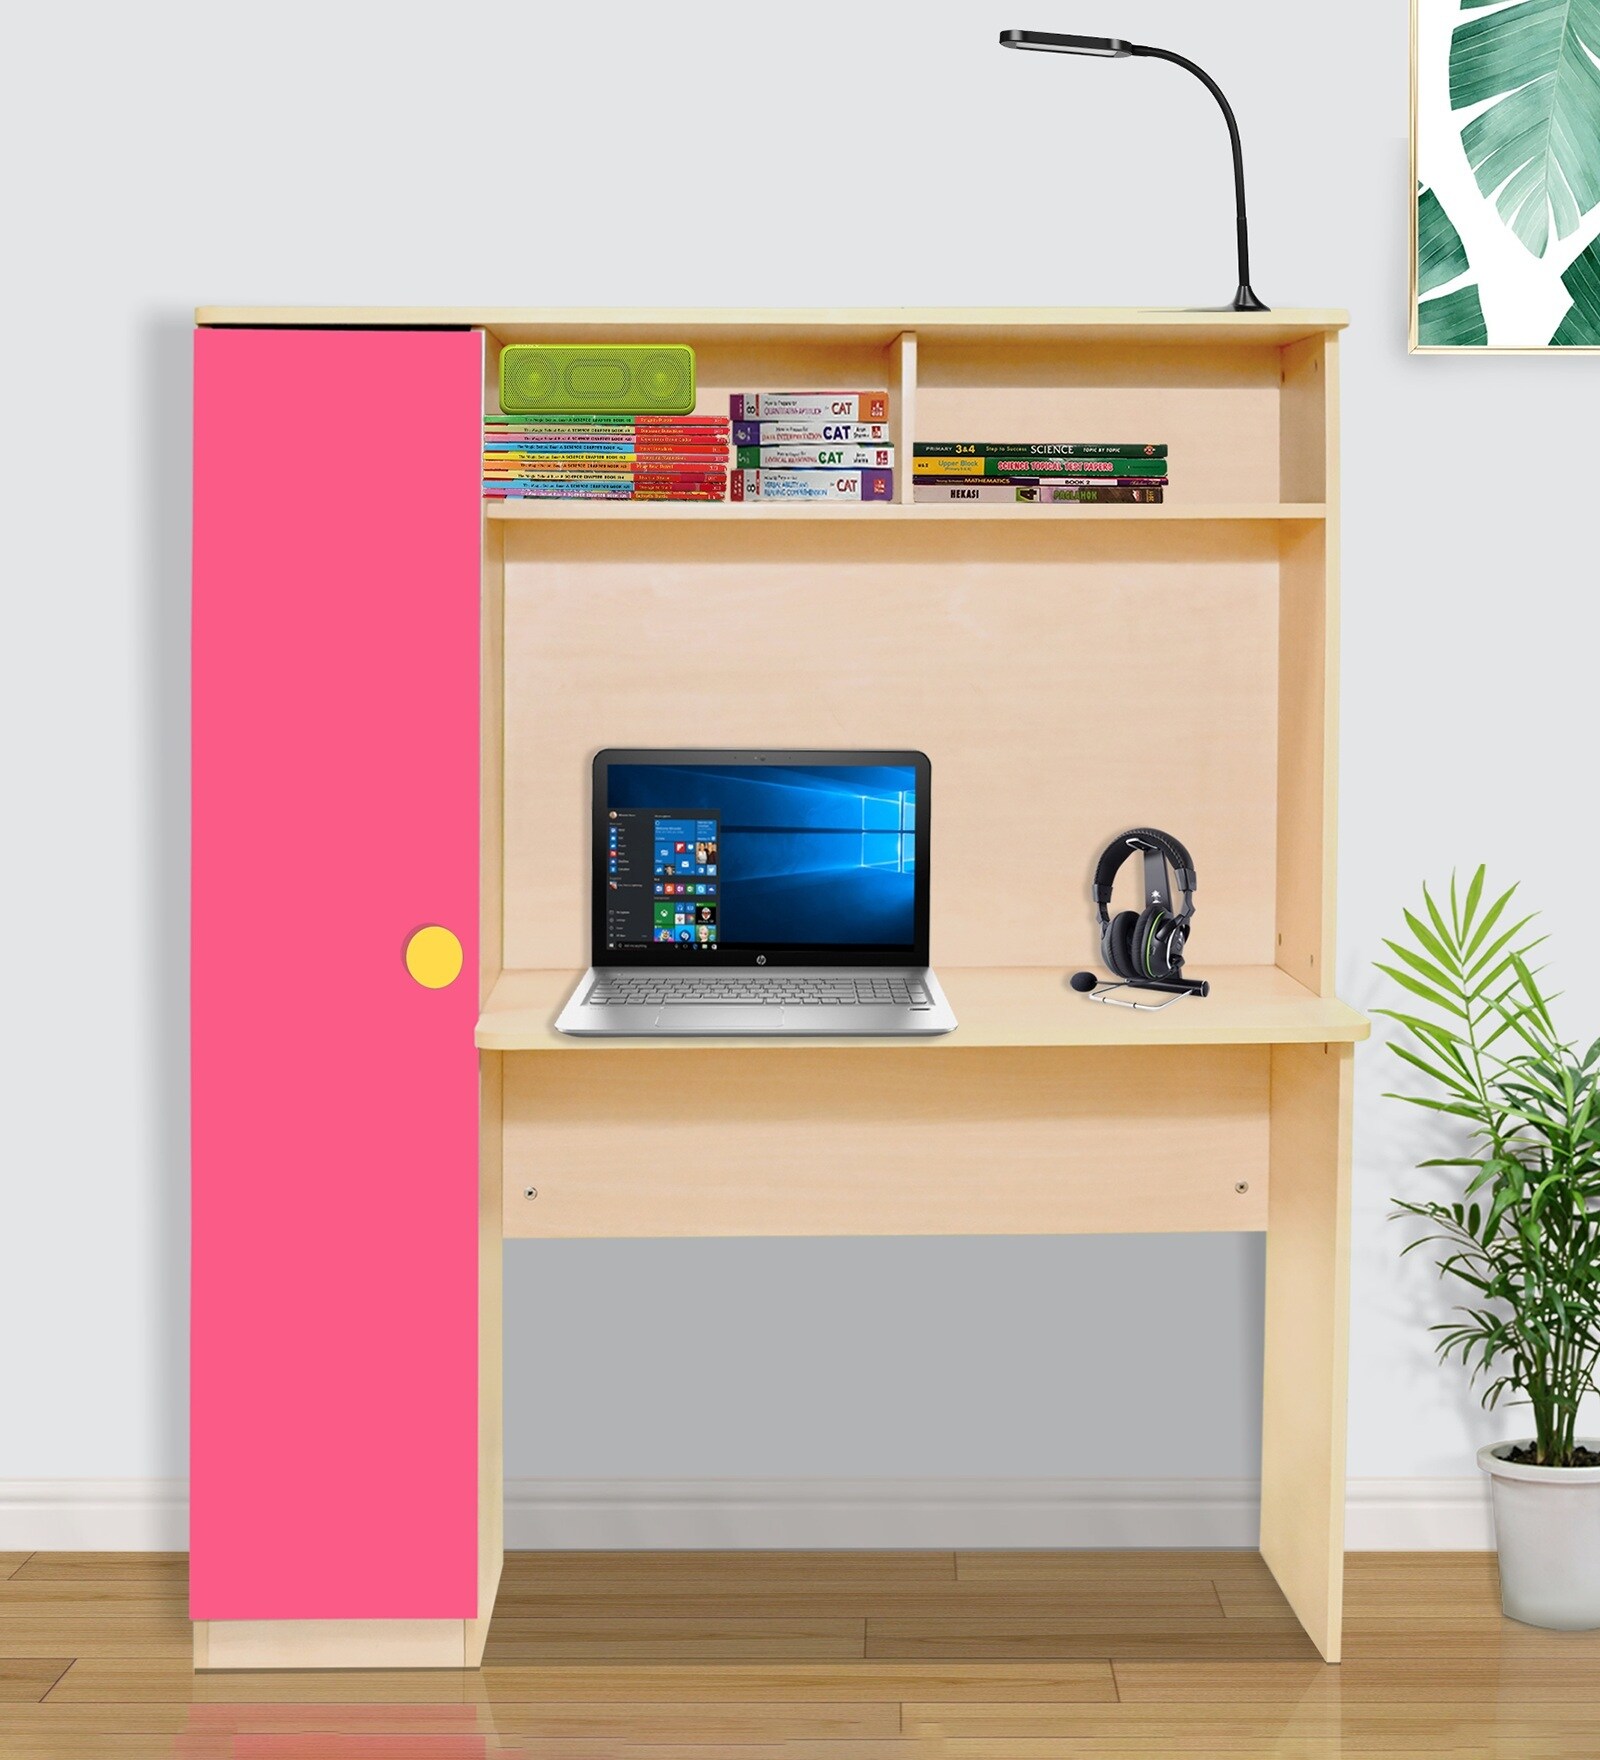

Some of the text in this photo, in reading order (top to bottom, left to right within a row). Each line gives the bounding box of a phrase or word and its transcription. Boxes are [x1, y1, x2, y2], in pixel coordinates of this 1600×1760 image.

[831, 402, 852, 414] CAT
[822, 426, 851, 440] CAT
[956, 444, 976, 454] 3&4
[1030, 444, 1074, 454] SCIENCE
[818, 452, 844, 464] CAT
[998, 461, 1114, 472] SCIENCE TOPICAL TEST PAPERS
[836, 479, 858, 492] CAT
[950, 489, 980, 498] HEKASI
[1053, 490, 1098, 500] PAGLAHOK
